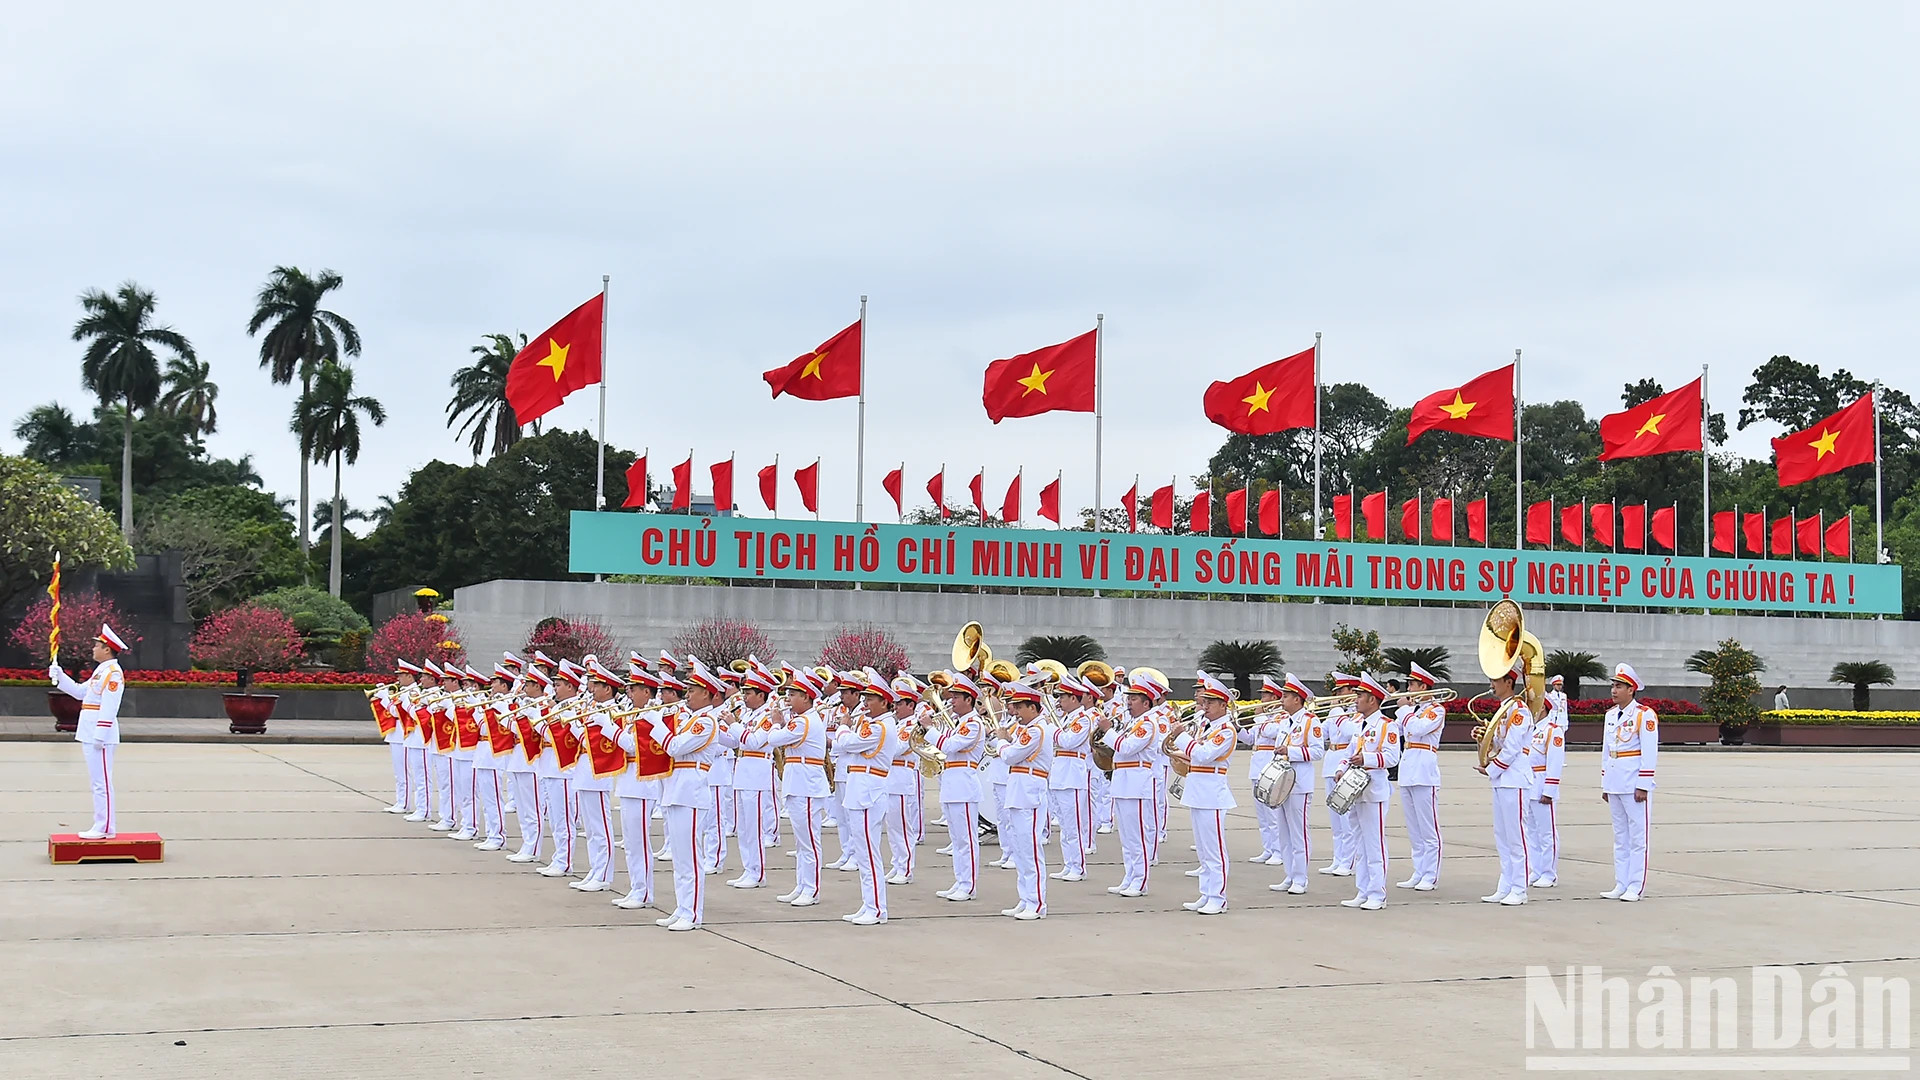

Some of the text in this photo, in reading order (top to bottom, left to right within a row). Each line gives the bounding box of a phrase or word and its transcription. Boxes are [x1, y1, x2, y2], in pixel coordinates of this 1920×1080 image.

[641, 518, 717, 568] CHỦ
[734, 531, 817, 576] TỊCH
[834, 523, 880, 573] HỒ
[897, 532, 955, 575] CHÍ
[972, 540, 1062, 579] MINH
[1079, 539, 1110, 580] VĨ
[1124, 546, 1179, 589] ĐẠI
[1195, 539, 1281, 586] SỐNG
[1296, 547, 1353, 588] MÃI
[1367, 555, 1465, 592] TRONG
[1478, 557, 1518, 600] SỰ
[1527, 558, 1631, 602] NGHIỆP
[1641, 557, 1695, 599] CỦA
[1706, 564, 1794, 603] CHÚNG
[1805, 572, 1837, 604] TA
